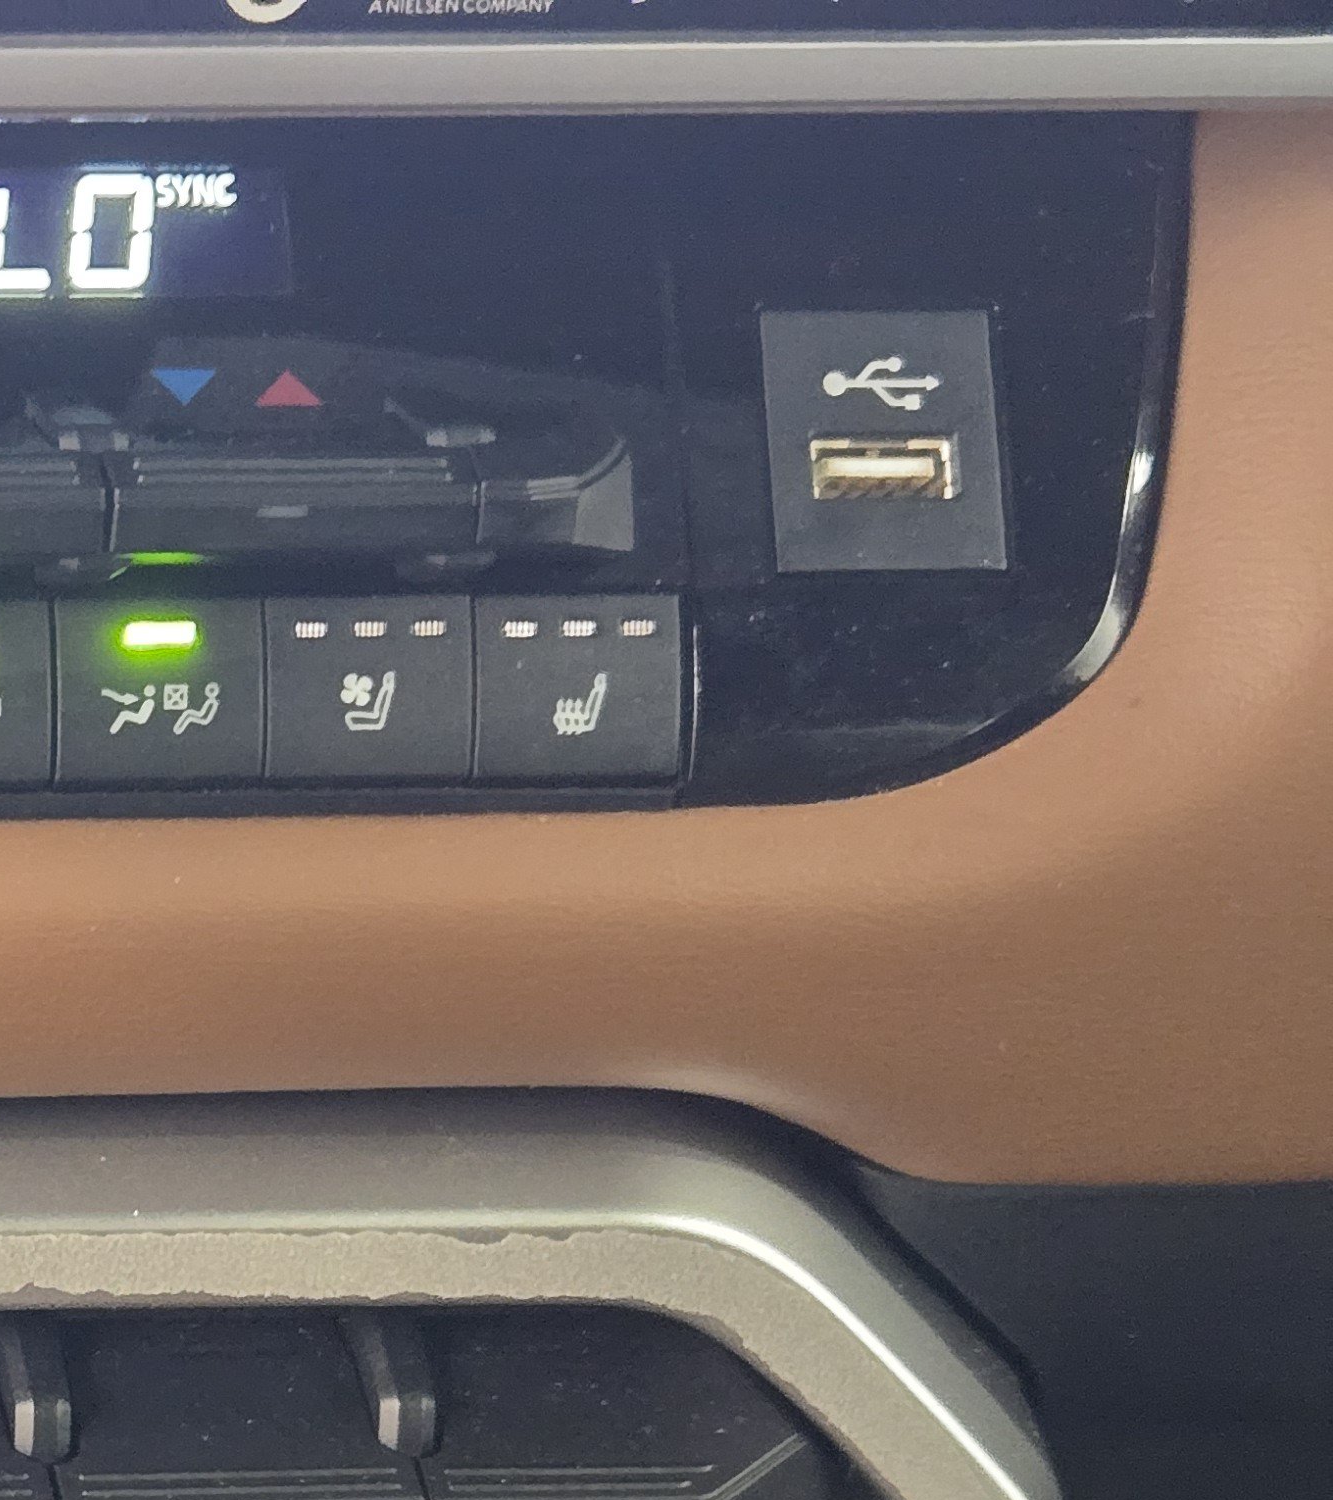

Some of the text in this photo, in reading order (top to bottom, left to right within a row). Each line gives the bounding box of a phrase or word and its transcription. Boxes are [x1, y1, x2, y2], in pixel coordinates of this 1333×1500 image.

[385, 0, 459, 15] NIELSEN
[462, 0, 554, 14] COMPANY
[155, 173, 237, 208] SYNC
